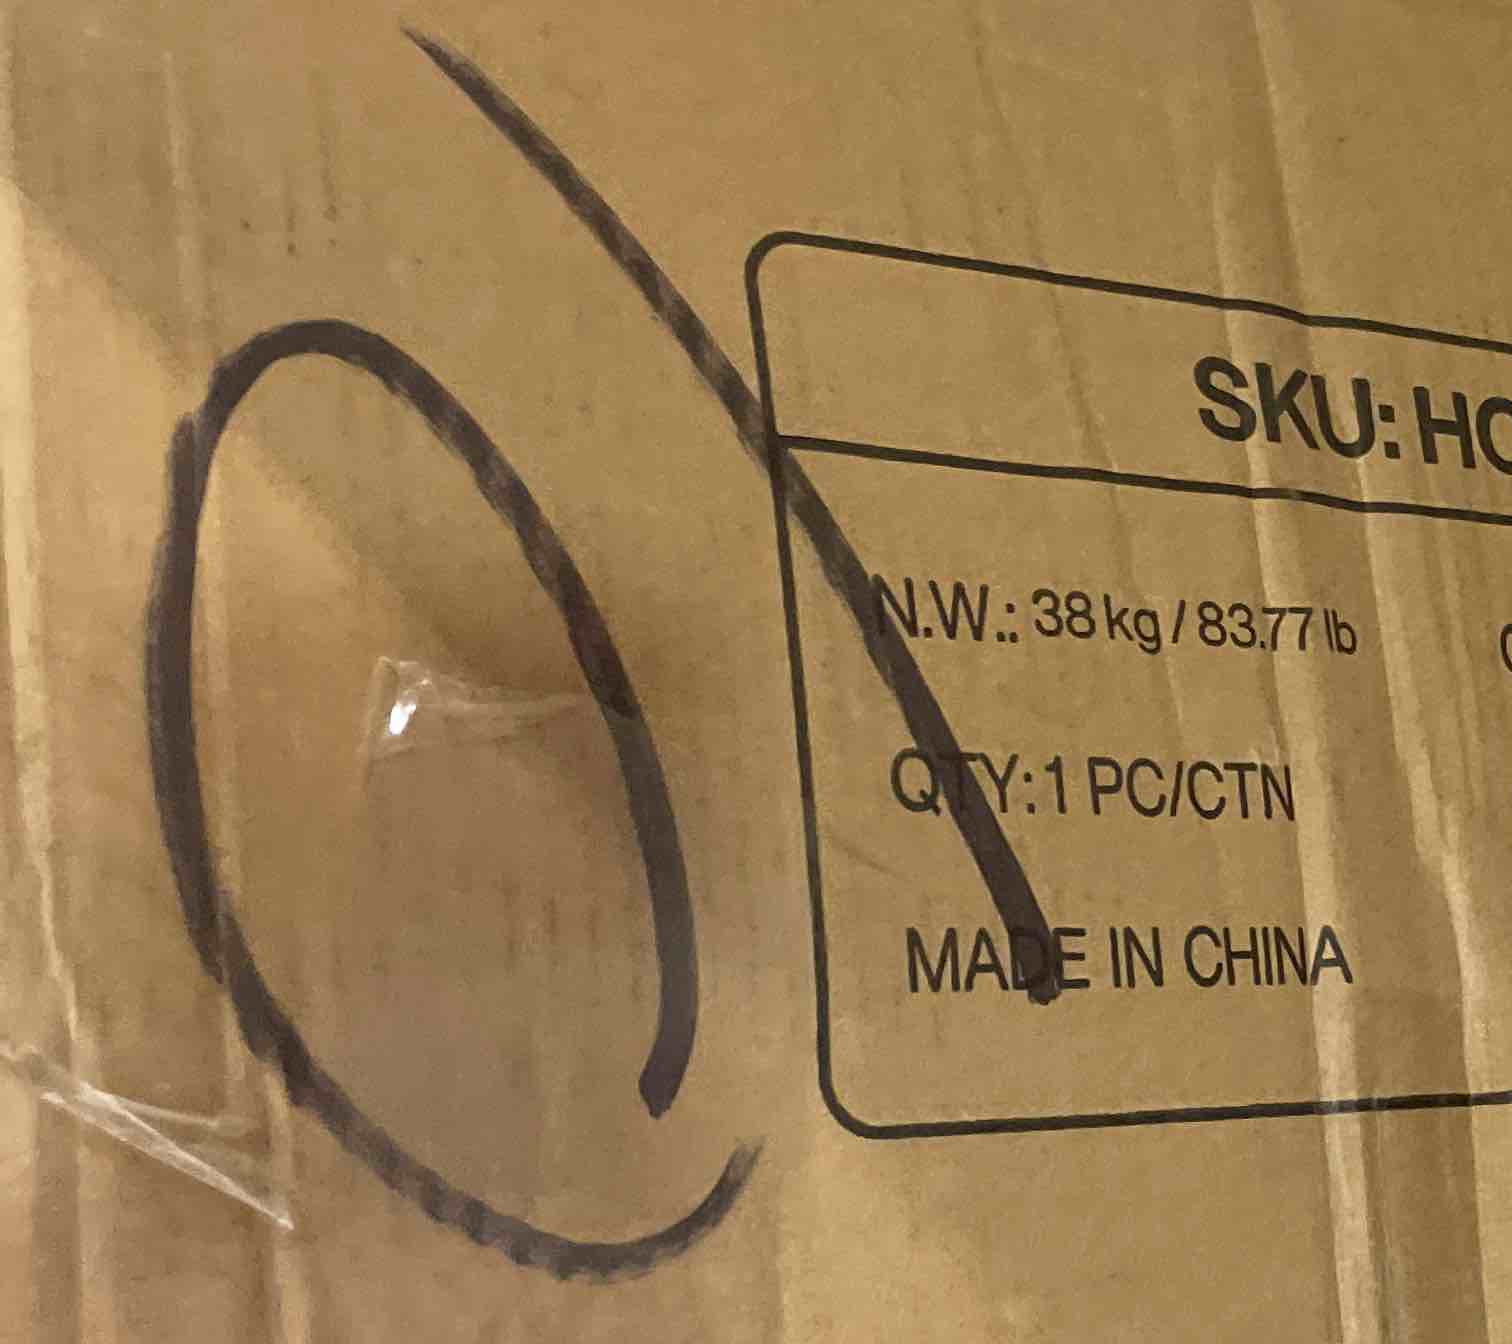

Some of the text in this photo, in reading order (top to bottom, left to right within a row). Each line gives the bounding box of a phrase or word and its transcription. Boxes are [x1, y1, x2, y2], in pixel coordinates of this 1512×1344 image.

[905, 924, 1354, 994] MADE IN CHINA
